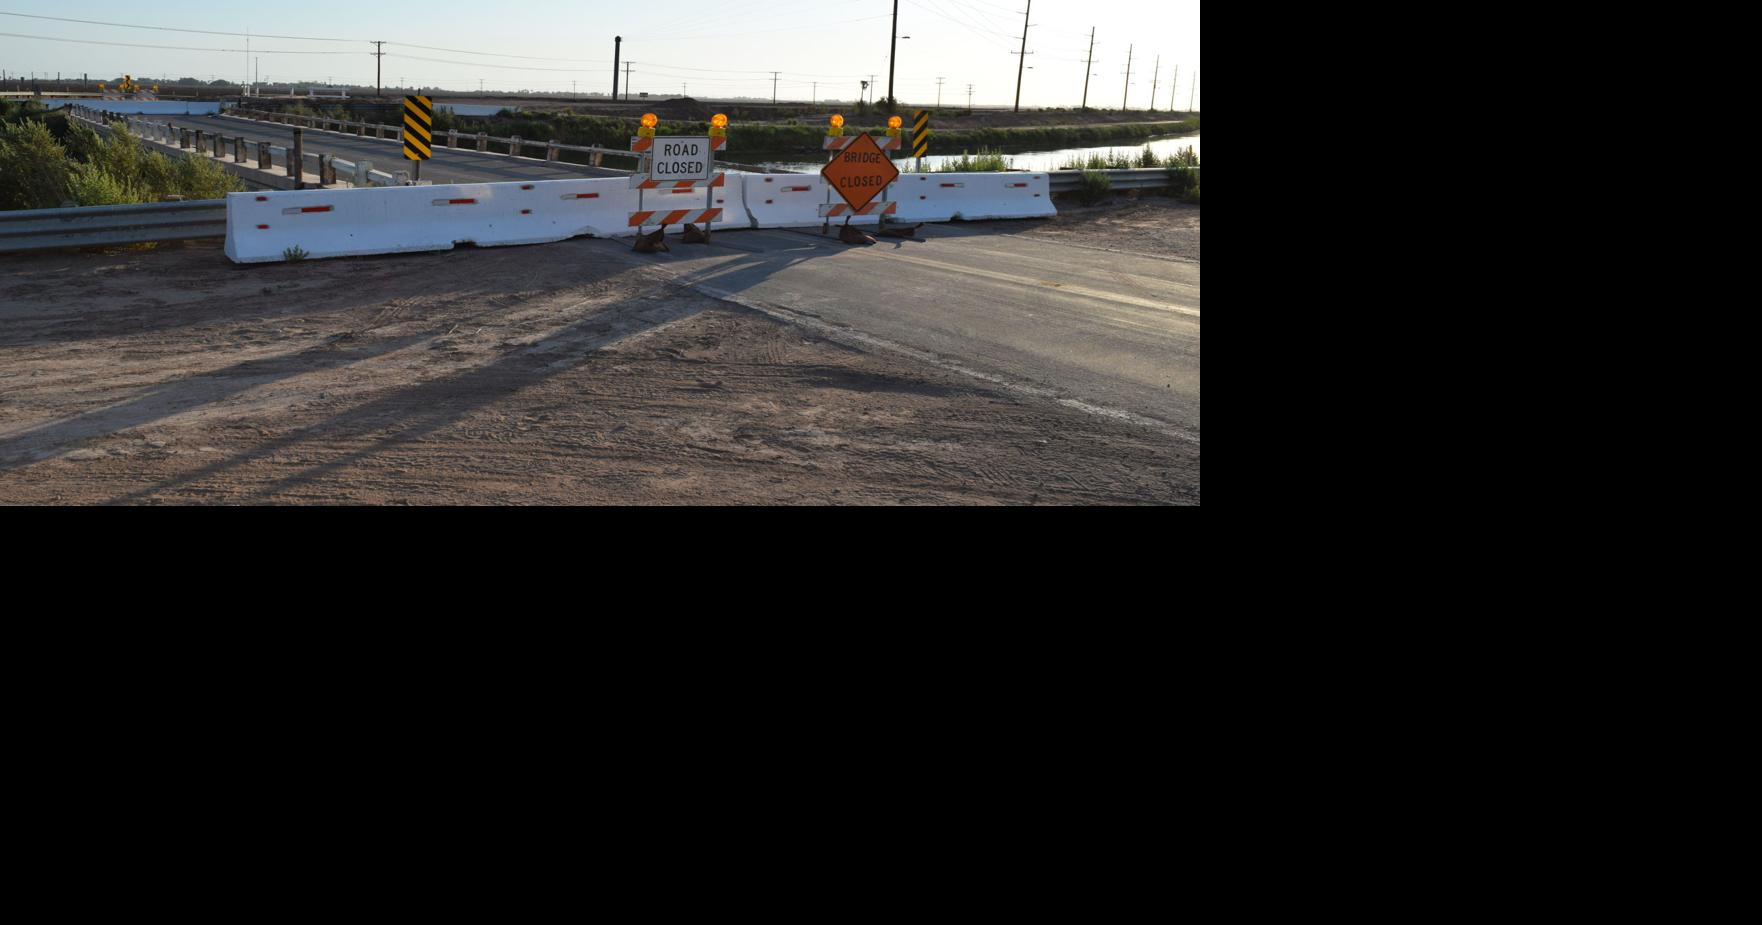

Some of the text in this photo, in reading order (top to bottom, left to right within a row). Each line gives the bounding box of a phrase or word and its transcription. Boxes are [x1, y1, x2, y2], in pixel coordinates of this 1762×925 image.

[664, 143, 699, 156] ROAD
[844, 151, 881, 164] BRIDGE
[657, 161, 703, 174] CLOSED
[840, 175, 882, 188] CLOSED
